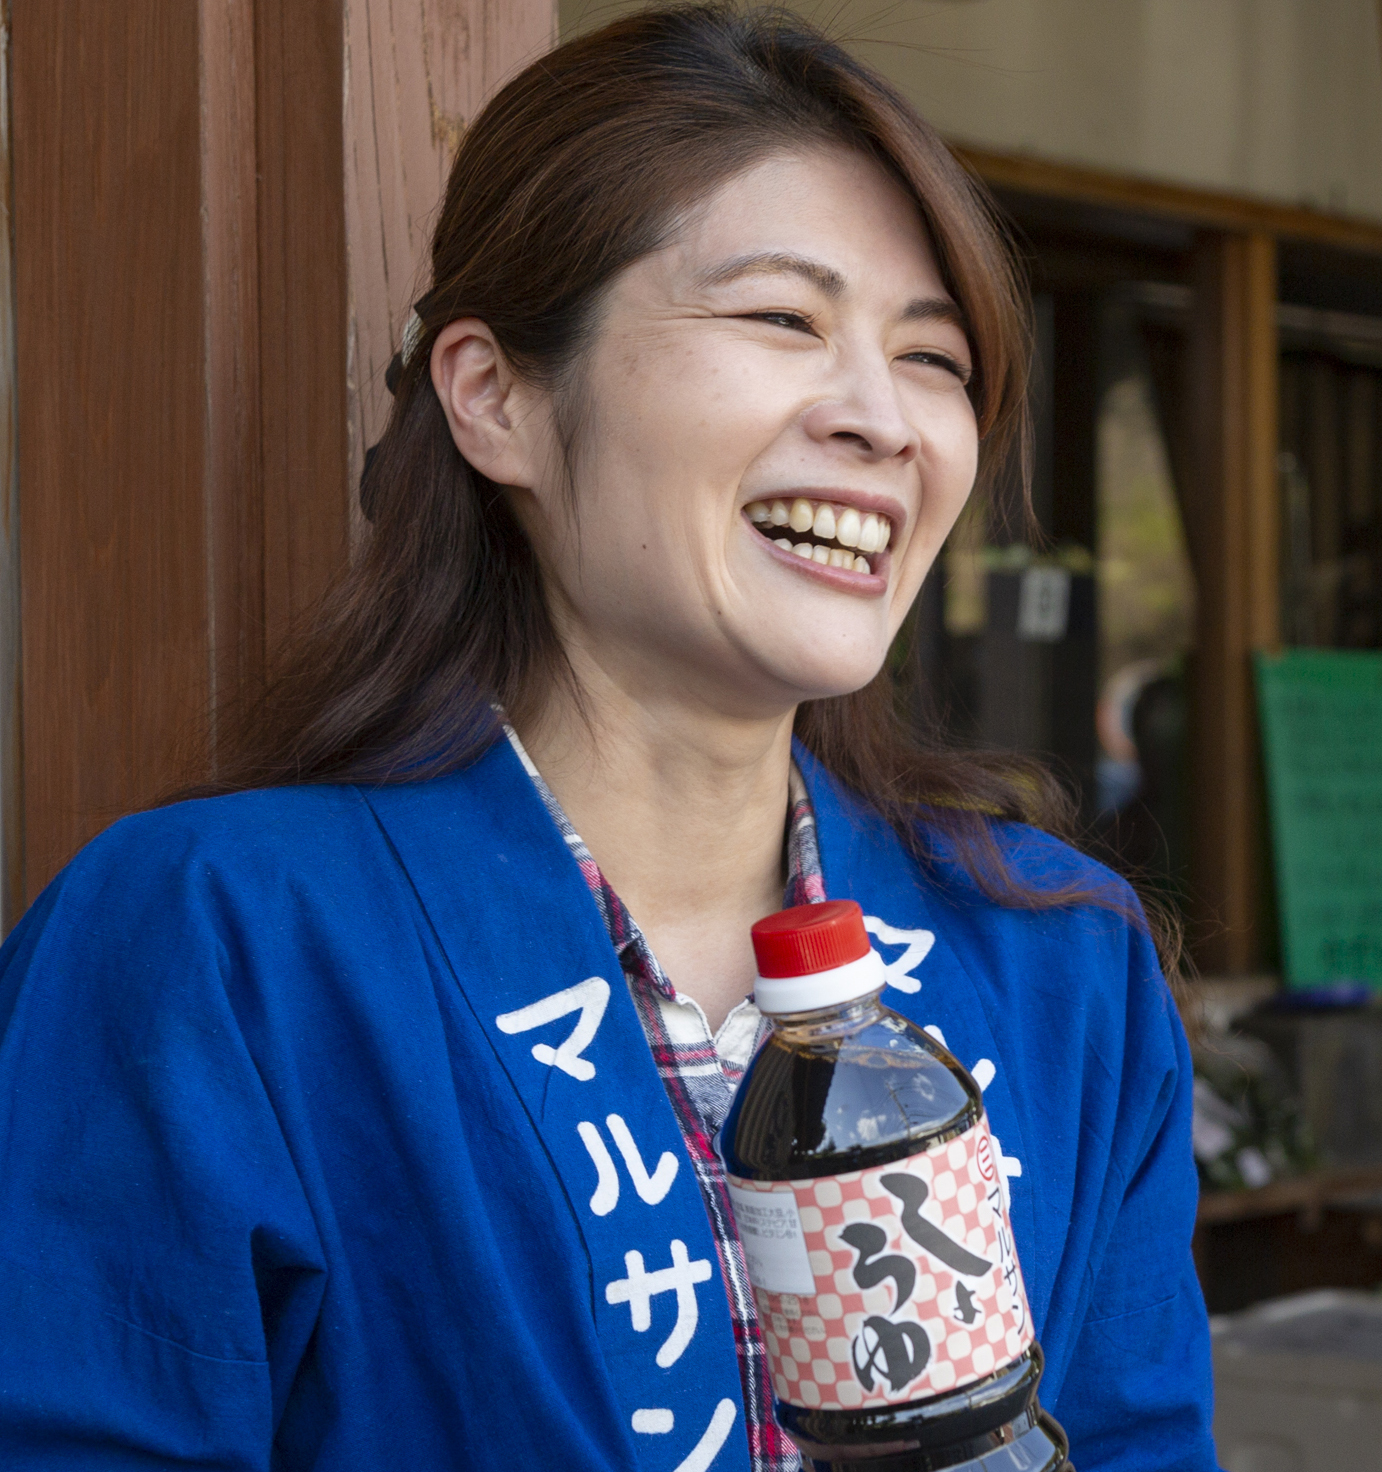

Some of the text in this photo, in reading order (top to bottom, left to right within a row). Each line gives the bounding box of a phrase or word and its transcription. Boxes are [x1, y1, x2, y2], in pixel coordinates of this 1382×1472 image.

[496, 976, 737, 1472] マルサン
[987, 1186, 1025, 1336] マルサン
